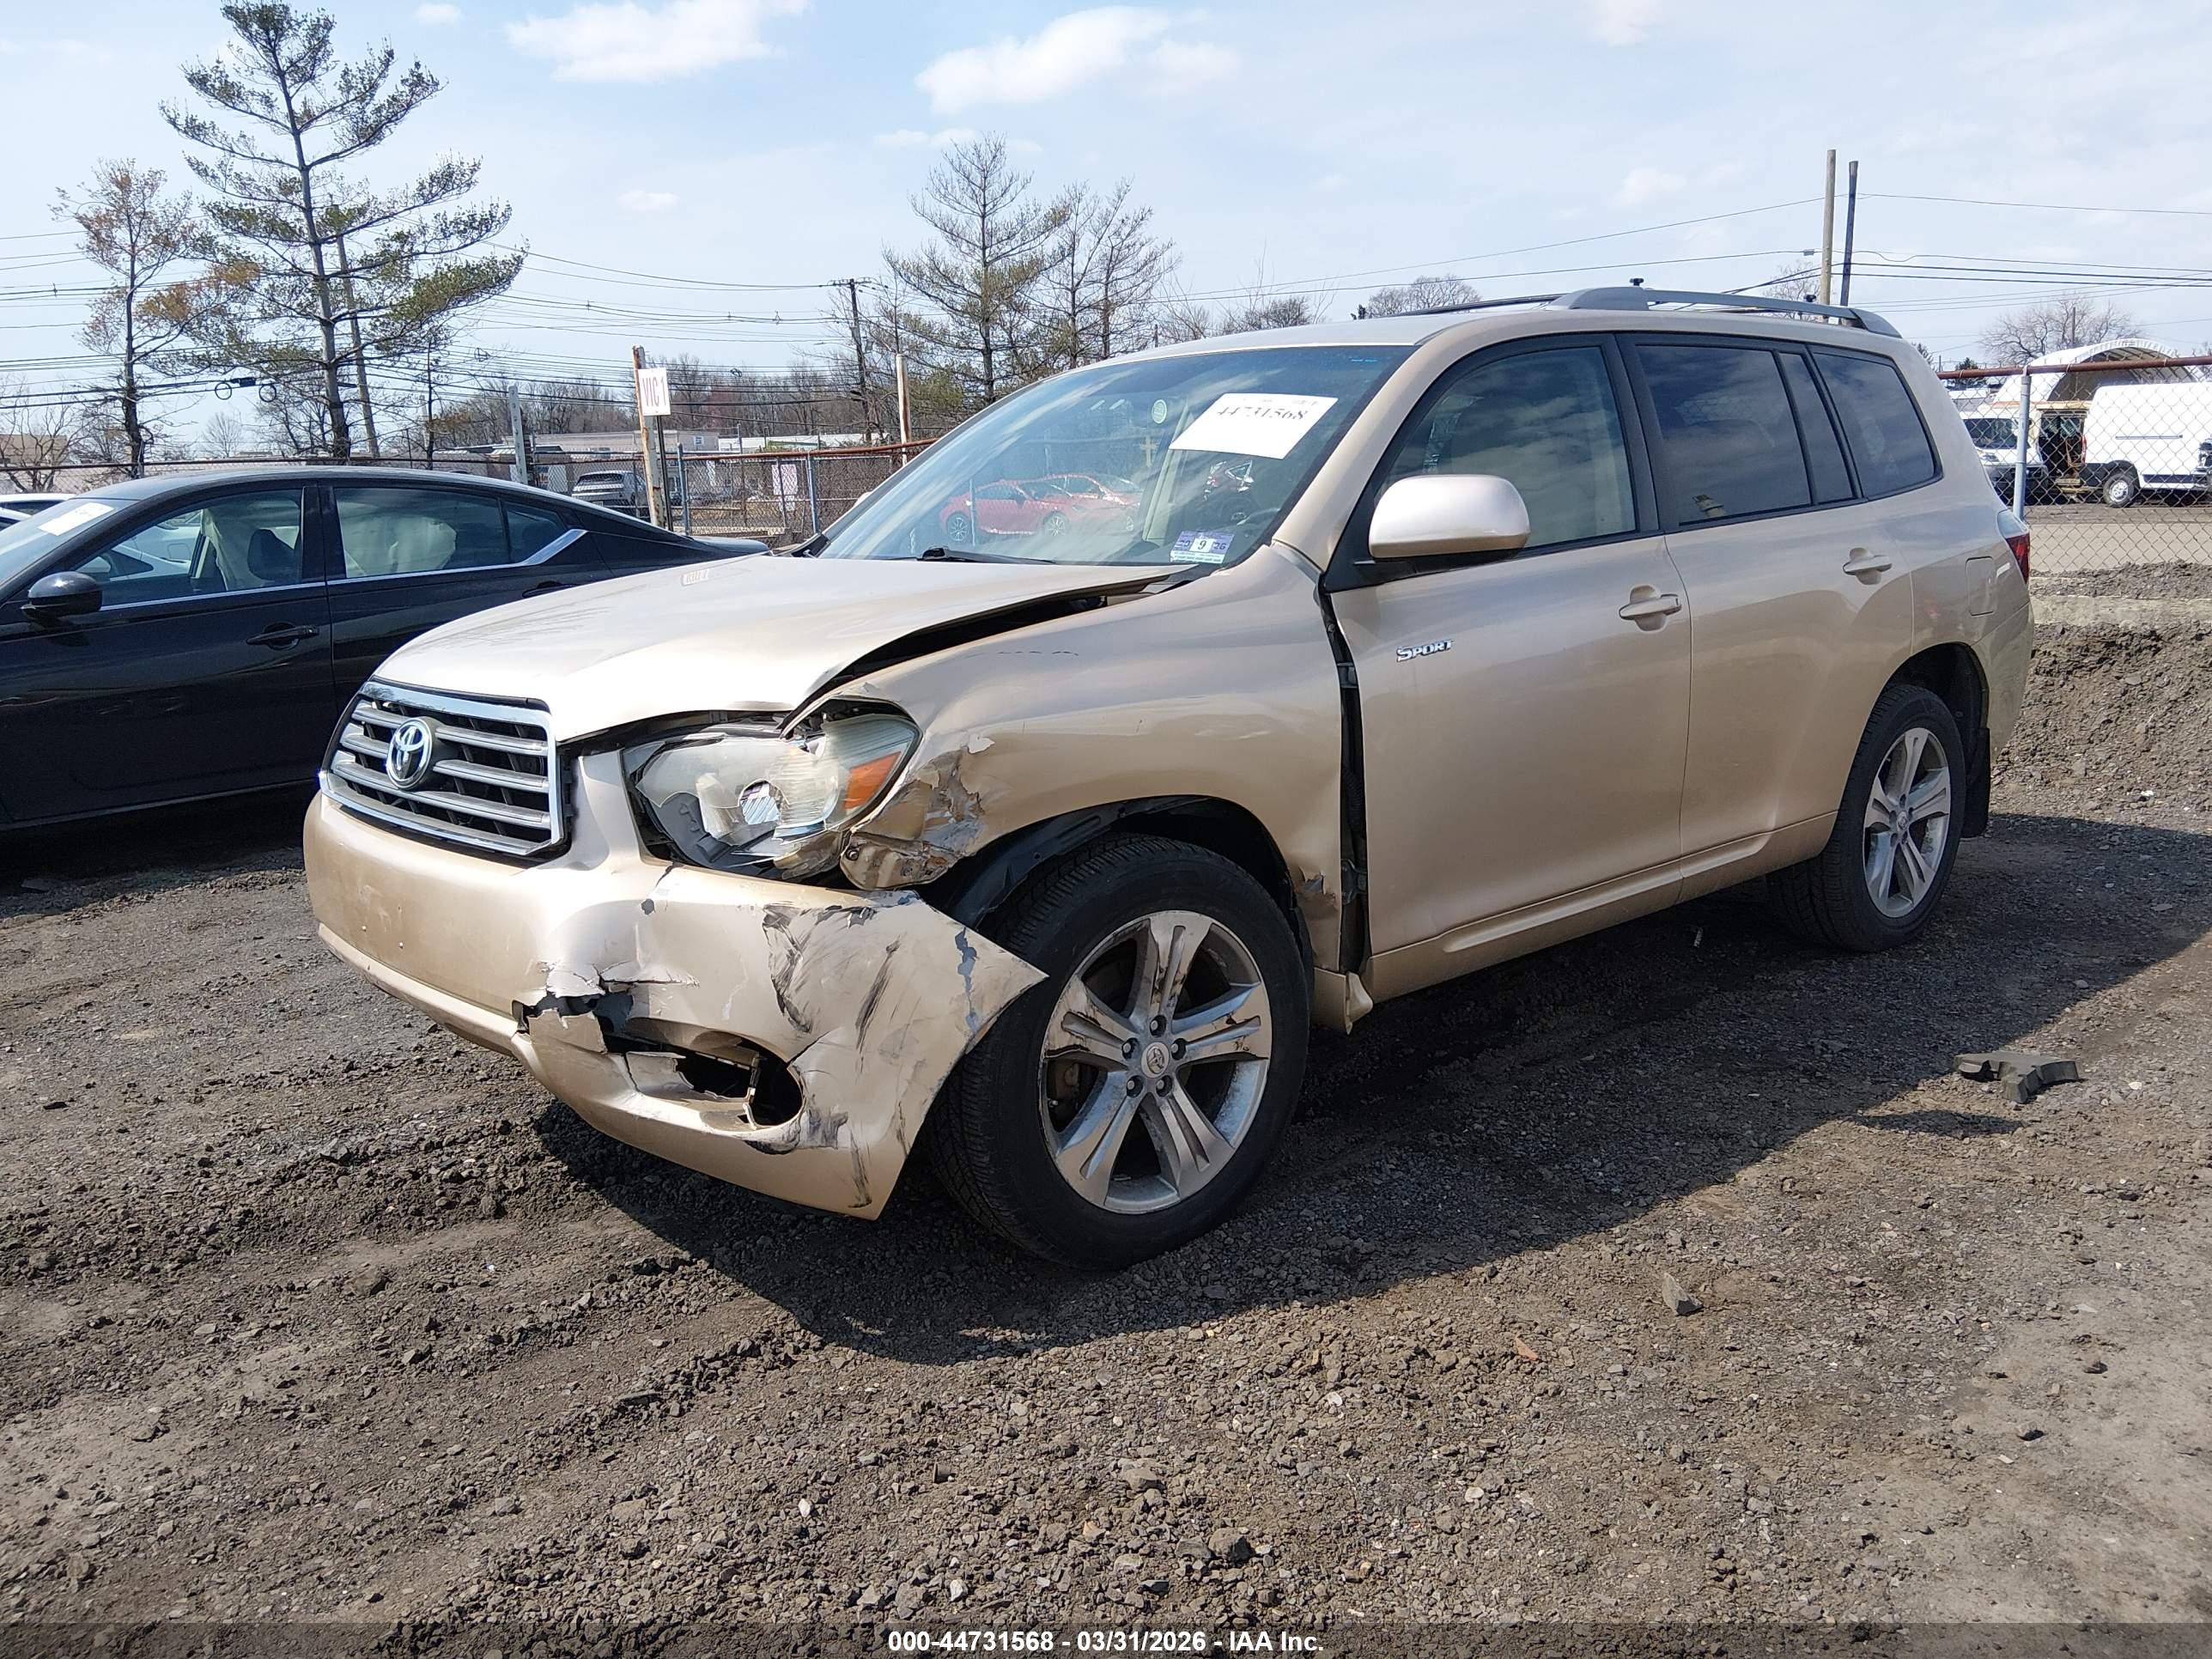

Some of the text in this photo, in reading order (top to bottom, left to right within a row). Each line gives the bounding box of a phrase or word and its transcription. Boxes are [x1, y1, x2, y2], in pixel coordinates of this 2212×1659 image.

[642, 376, 659, 406] VIC
[1198, 539, 1207, 550] 9
[1396, 639, 1454, 662] SPORT
